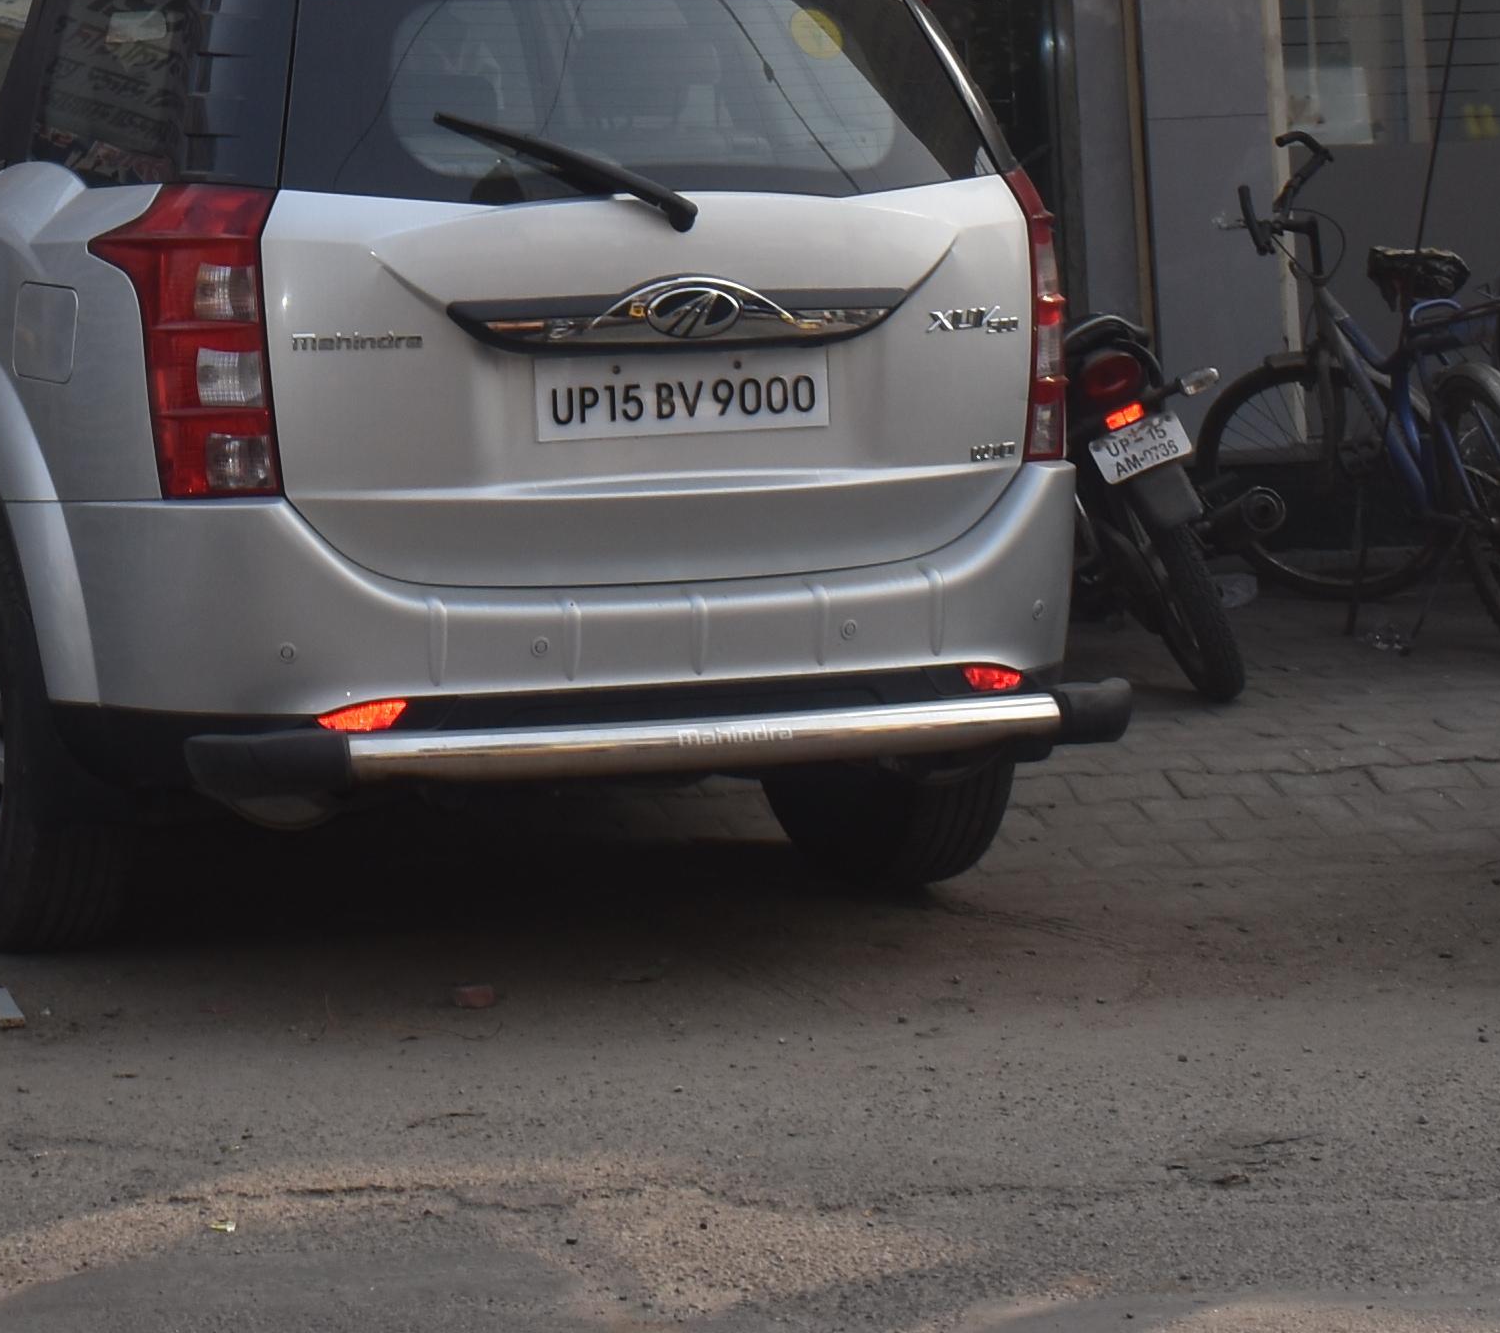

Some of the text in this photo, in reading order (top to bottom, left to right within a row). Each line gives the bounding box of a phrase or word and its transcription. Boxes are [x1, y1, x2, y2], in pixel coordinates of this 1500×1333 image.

[291, 330, 424, 352] Mahindra
[551, 374, 816, 426] UP15 BV 9000
